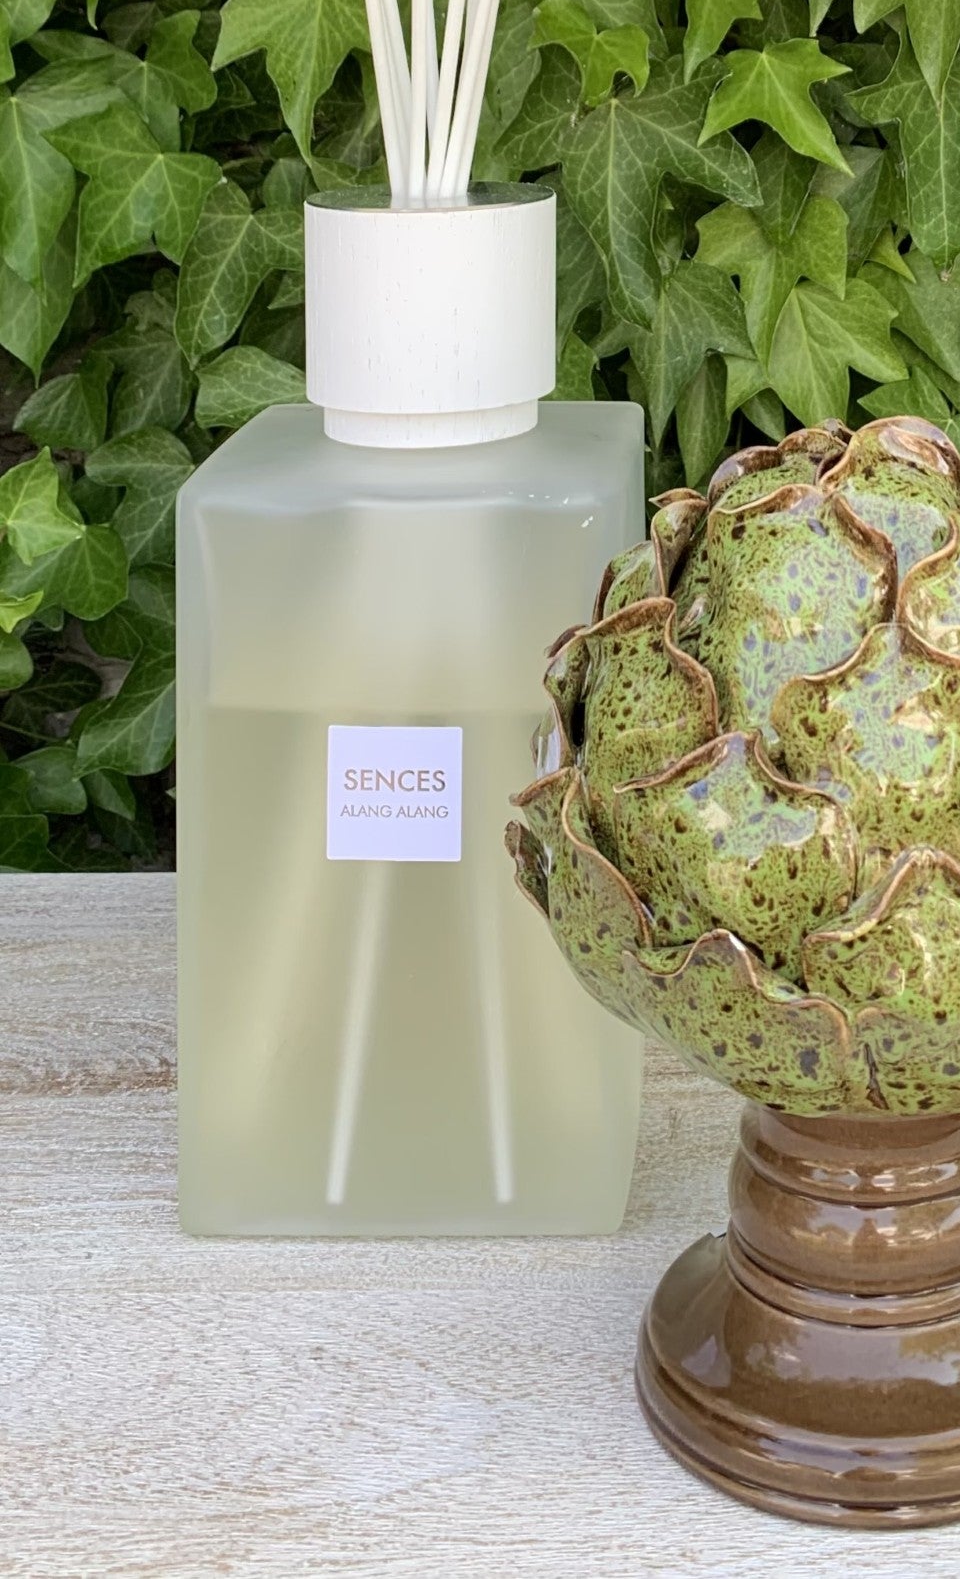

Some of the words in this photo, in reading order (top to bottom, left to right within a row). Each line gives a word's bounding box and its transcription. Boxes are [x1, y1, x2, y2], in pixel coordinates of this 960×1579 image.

[343, 769, 446, 792] SENCES
[340, 804, 392, 818] ALANG
[396, 805, 449, 819] ALANG
